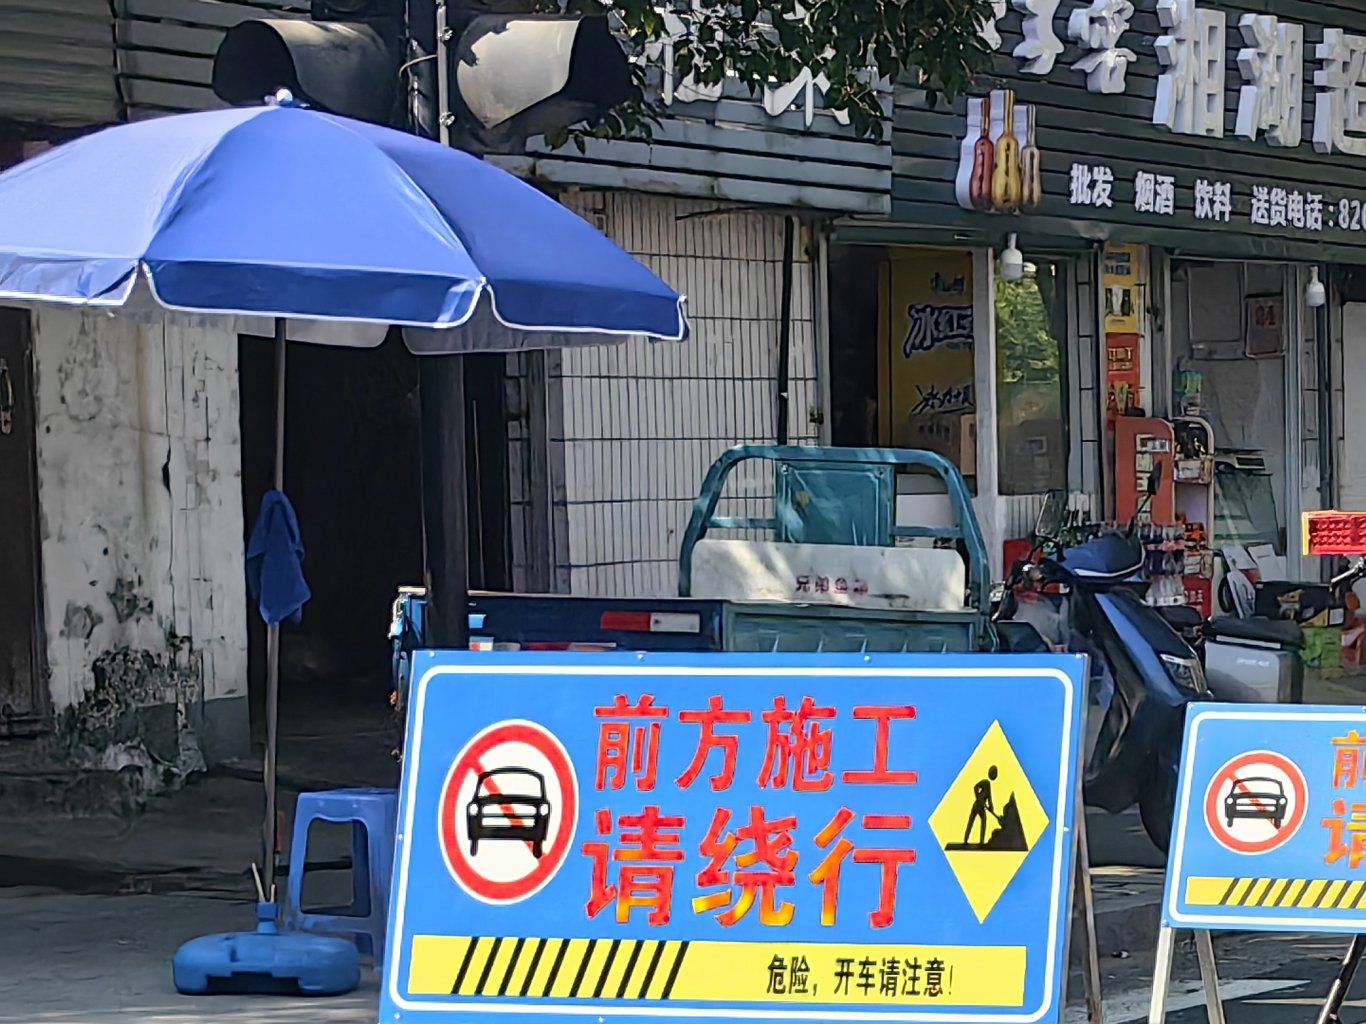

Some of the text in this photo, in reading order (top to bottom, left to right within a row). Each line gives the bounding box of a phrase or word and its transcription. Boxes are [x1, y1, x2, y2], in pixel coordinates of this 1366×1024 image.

[1069, 163, 1114, 208] 批发
[1134, 170, 1175, 216] 烟酒
[1194, 179, 1231, 223] 饮料
[593, 693, 919, 793] 前方施工
[581, 804, 917, 929] 请绕行
